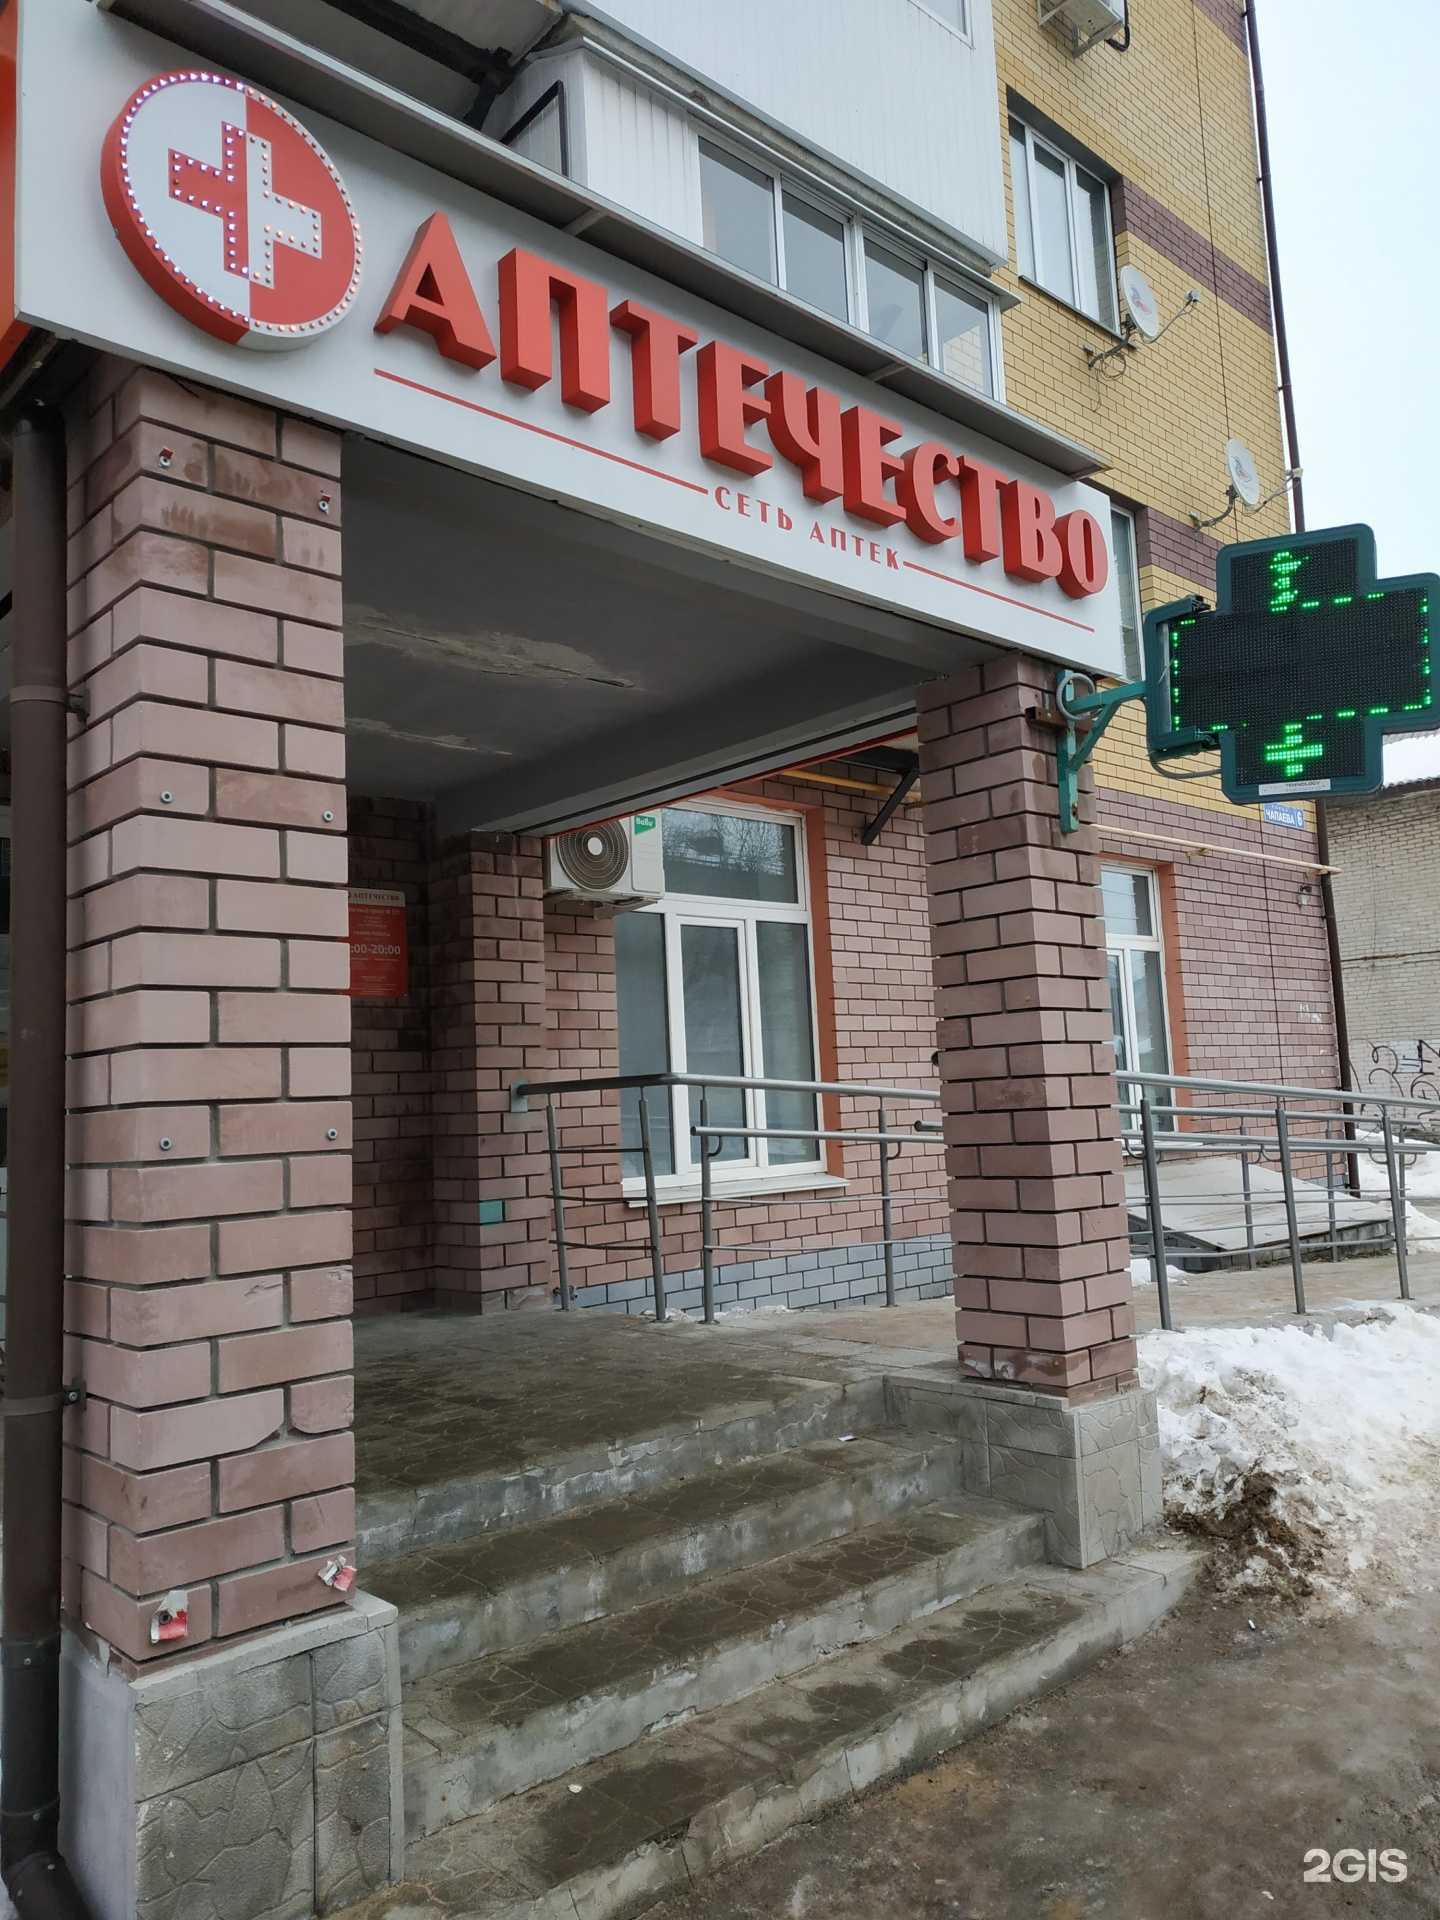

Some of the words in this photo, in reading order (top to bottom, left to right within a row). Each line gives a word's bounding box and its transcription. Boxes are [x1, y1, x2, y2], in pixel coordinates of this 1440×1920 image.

[374, 211, 1108, 599] АПТЕЧЕСТВО
[714, 486, 793, 531] СЕТЬ
[809, 521, 899, 570] АПТЕК
[1265, 808, 1295, 825] ЧАПАЕВА
[1297, 810, 1303, 827] 6
[350, 944, 401, 955] :00-20:00
